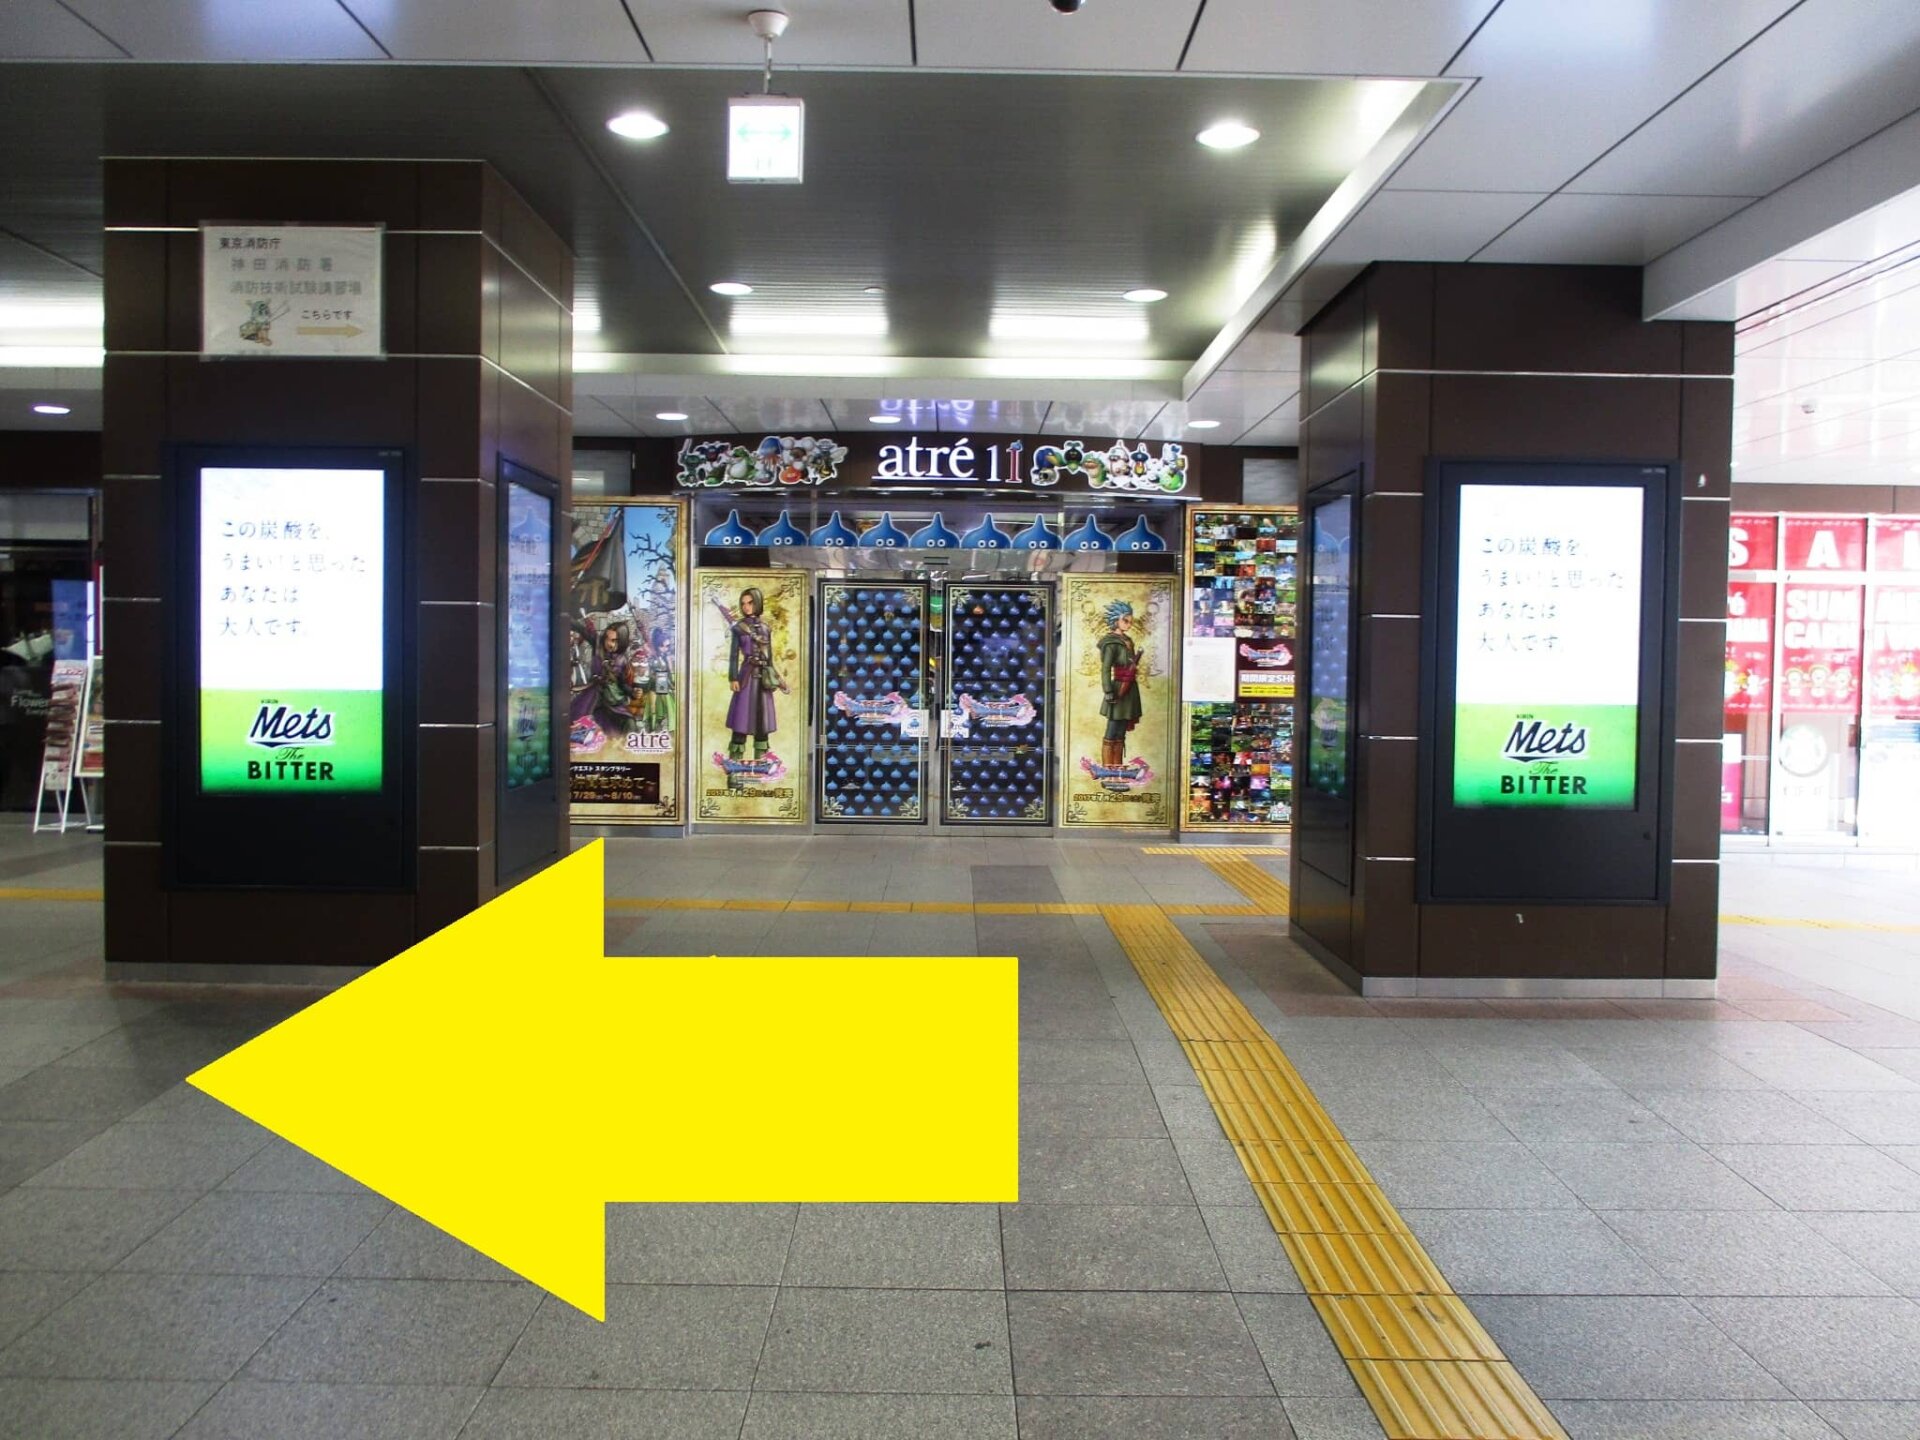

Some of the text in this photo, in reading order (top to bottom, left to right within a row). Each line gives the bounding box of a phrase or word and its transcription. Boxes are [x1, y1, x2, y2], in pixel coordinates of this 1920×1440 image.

[219, 237, 281, 250] 東京消防庁
[301, 309, 353, 320] こちらです
[877, 436, 976, 479] atré
[220, 585, 299, 603] あなたは
[1478, 602, 1560, 619] あなたは
[250, 706, 331, 739] Mets
[628, 730, 670, 748] atré
[1504, 721, 1586, 754] Mets
[276, 747, 305, 760] The
[248, 761, 335, 780] BITTER
[1529, 761, 1559, 774] The
[1501, 775, 1588, 795] BITTER
